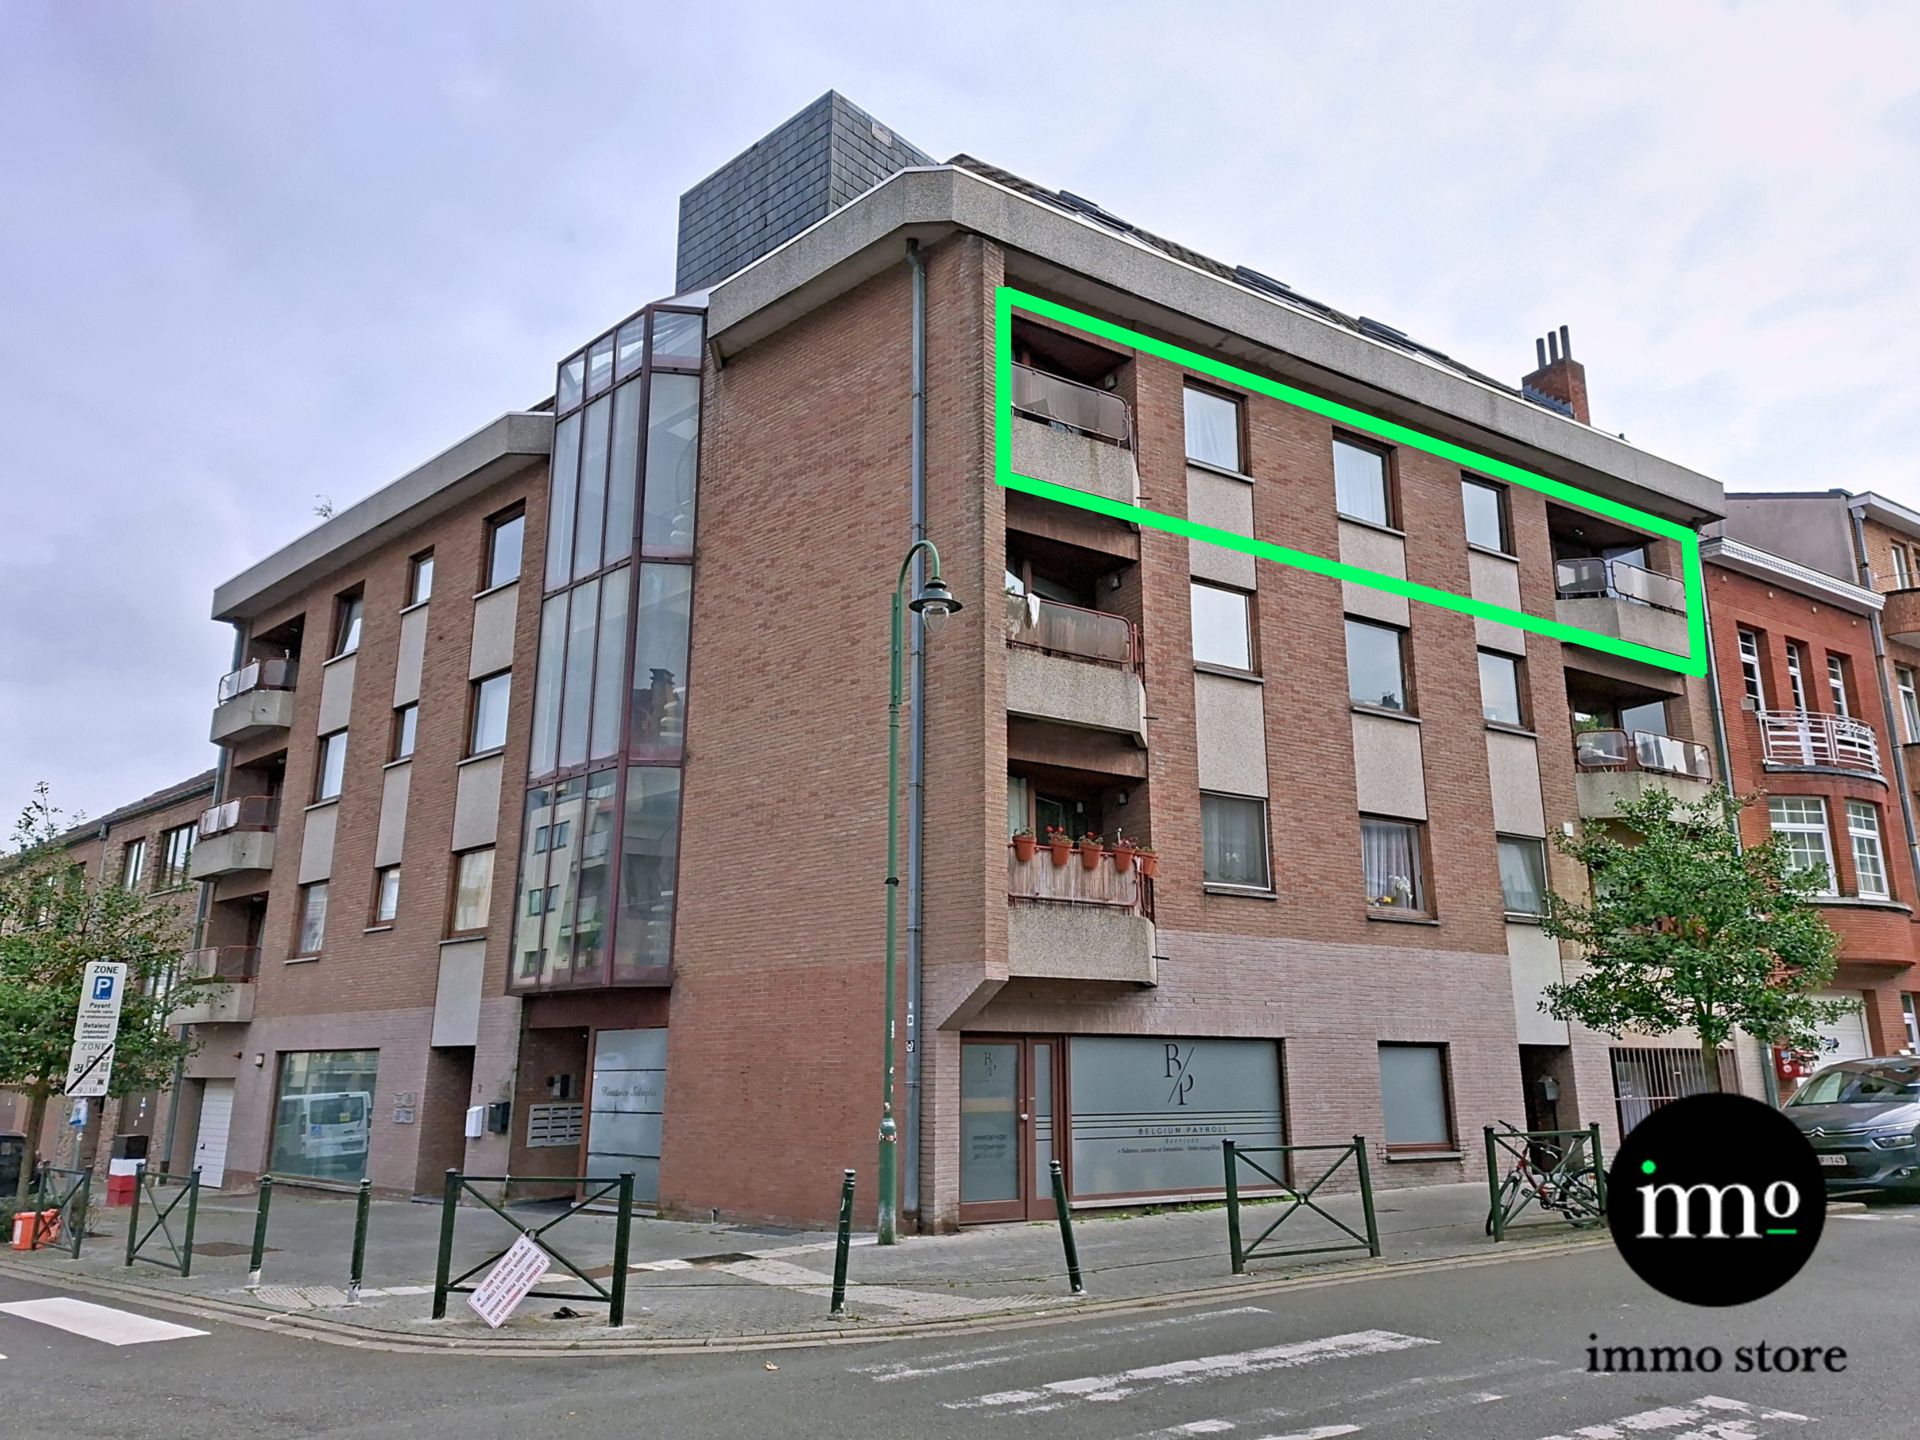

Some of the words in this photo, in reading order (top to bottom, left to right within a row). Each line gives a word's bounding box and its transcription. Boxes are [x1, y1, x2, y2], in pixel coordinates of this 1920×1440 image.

[93, 965, 119, 974] ZONE
[95, 978, 111, 996] P
[81, 1043, 108, 1051] ZONE
[1138, 1127, 1181, 1136] BELGIUM
[1186, 1126, 1228, 1134] PAYROLL
